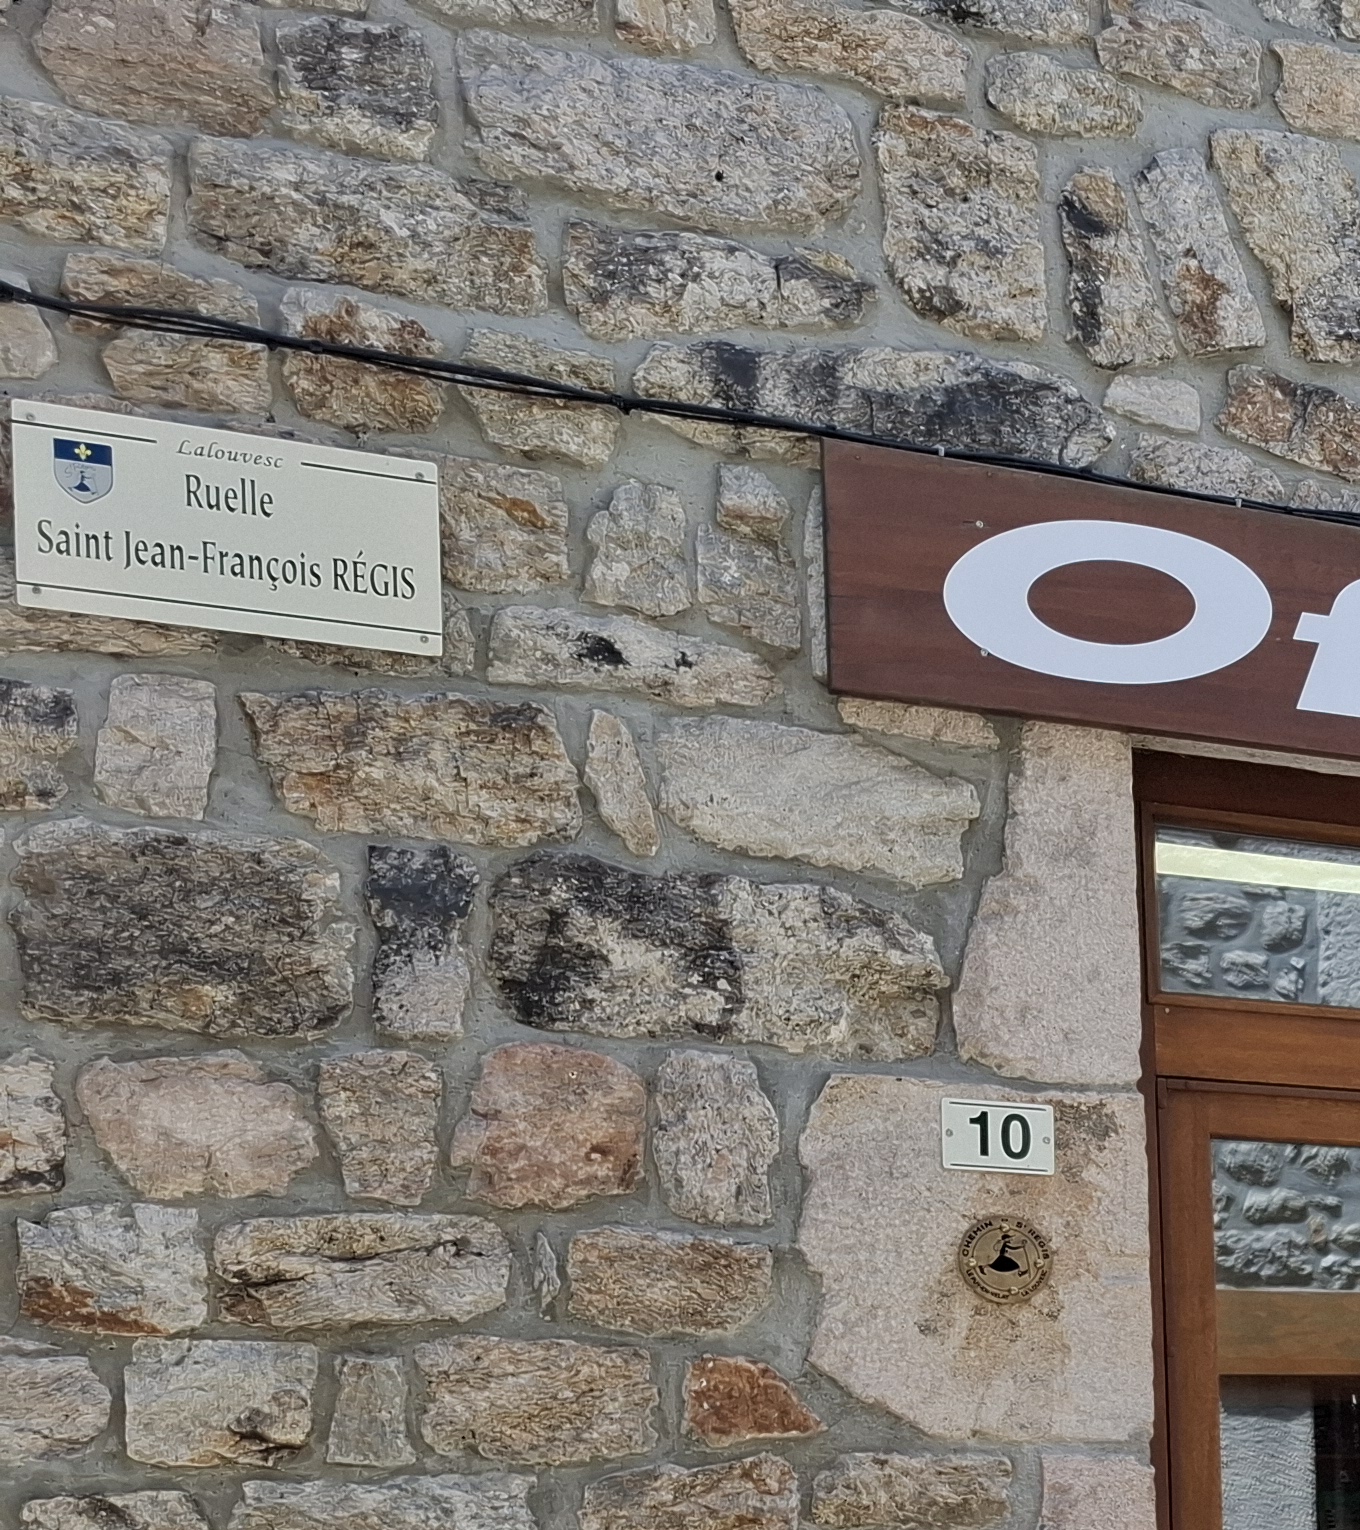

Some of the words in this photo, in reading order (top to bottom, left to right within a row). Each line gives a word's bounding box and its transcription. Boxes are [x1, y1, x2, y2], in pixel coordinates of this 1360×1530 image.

[175, 439, 284, 469] Lalouvesc
[184, 474, 275, 518] Ruelle
[36, 519, 113, 562] Saint
[123, 529, 322, 591] Jean-François
[332, 549, 417, 600] RÉGIS
[969, 1111, 1031, 1160] 10
[962, 1221, 993, 1257] CHEMIN
